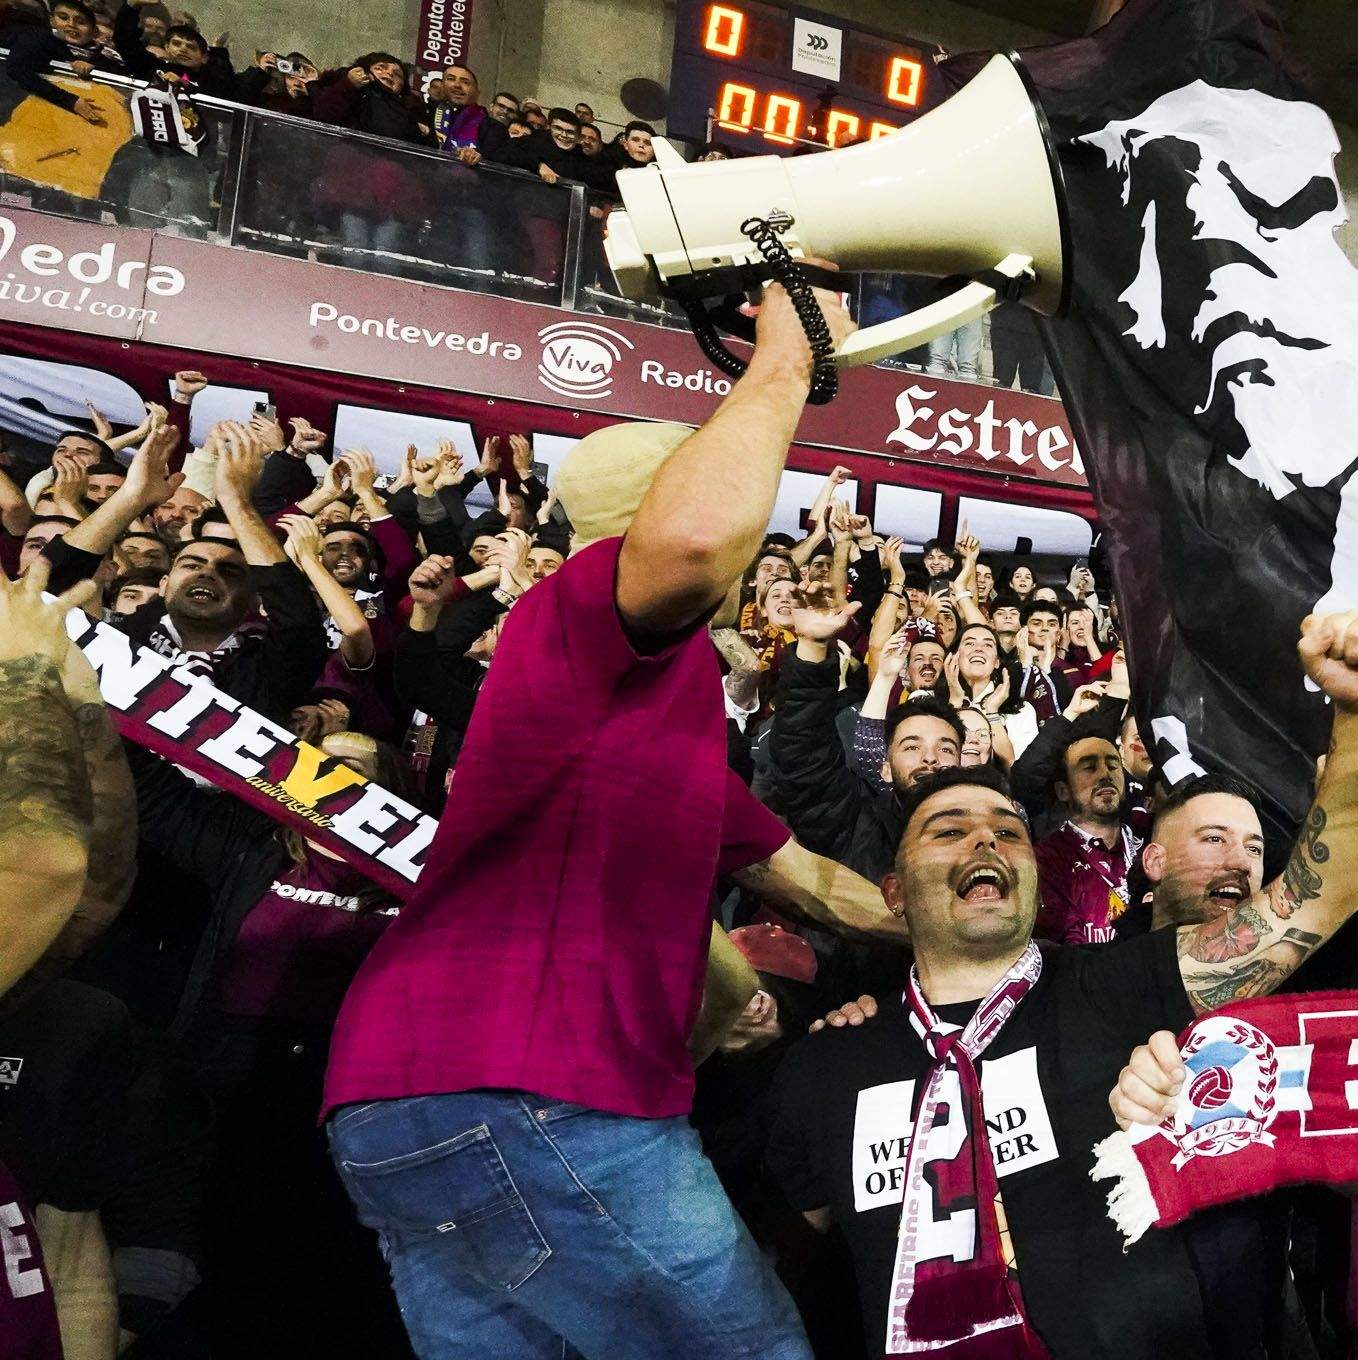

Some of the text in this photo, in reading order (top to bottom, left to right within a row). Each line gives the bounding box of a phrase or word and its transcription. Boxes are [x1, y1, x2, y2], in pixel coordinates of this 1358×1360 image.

[423, 0, 446, 62] Deputa
[443, 0, 468, 65] Ponteve
[705, 5, 743, 56] 0
[888, 57, 921, 105] 0
[308, 302, 733, 396] Pontevedra Viva Radio
[245, 775, 336, 827] aniversario
